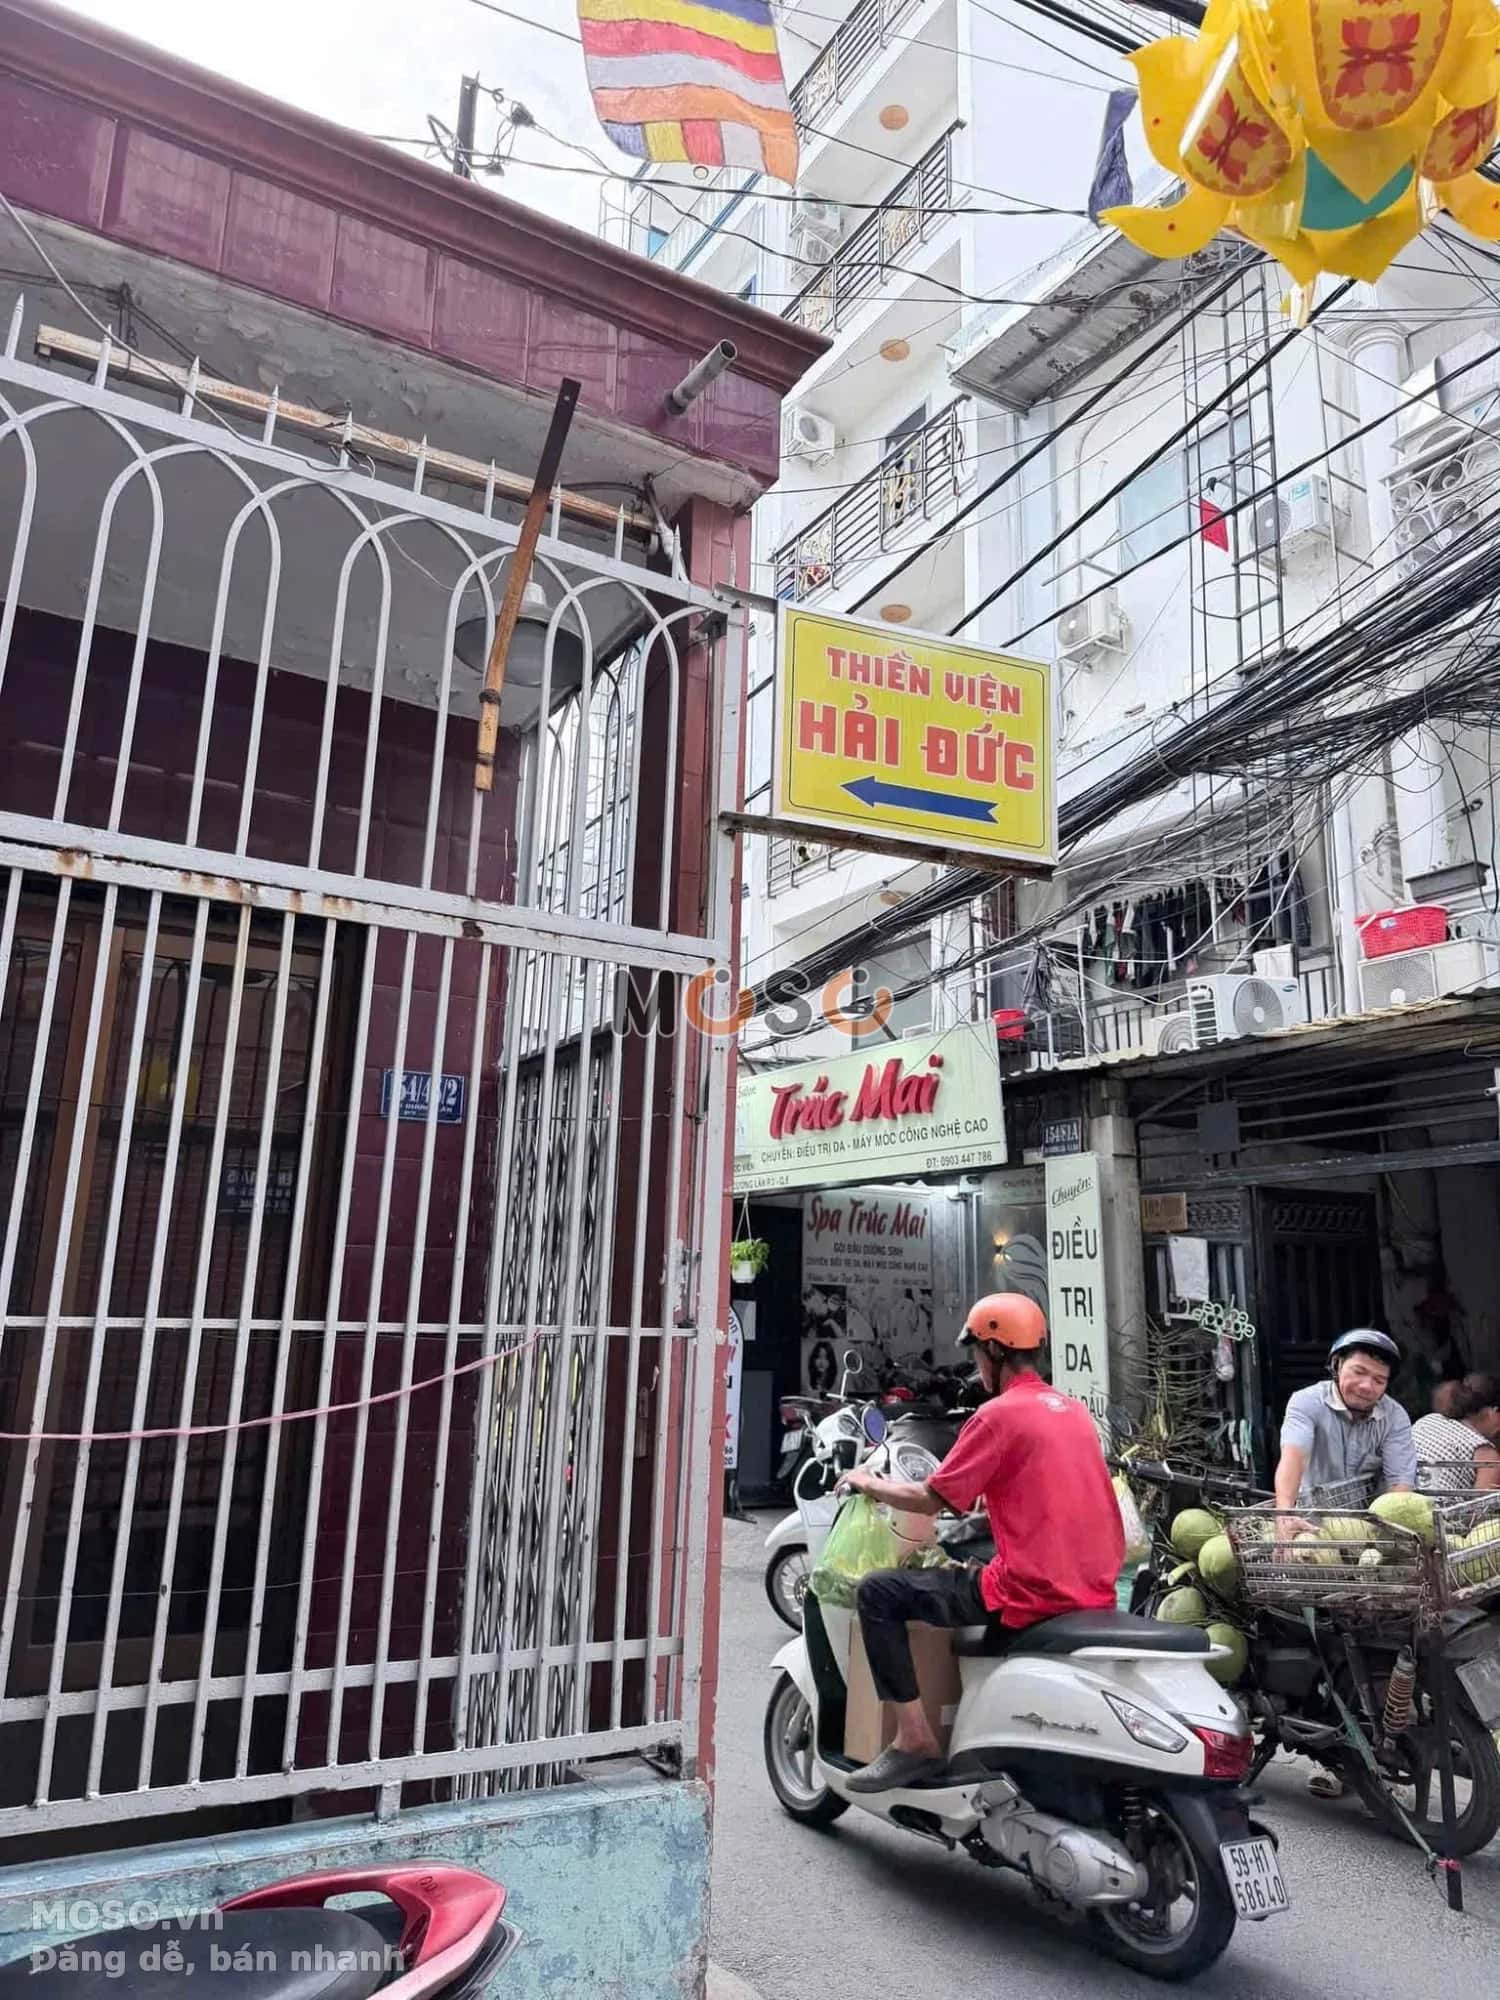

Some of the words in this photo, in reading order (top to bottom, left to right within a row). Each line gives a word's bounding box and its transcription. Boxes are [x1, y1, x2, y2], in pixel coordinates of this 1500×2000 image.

[827, 647, 931, 697] THIỀN
[944, 671, 1023, 717] VIỆN
[799, 693, 900, 768] HẢI
[920, 722, 1035, 791] ĐỨC
[769, 1075, 849, 1140] Trúc
[850, 1054, 945, 1122] Mai
[833, 1140, 846, 1153] DA
[852, 1133, 873, 1150] MÁY
[899, 1126, 929, 1144] CÔNG
[931, 1118, 962, 1139] NGHỆ
[964, 1117, 989, 1135] CAO
[807, 1194, 842, 1242] Spa
[849, 1198, 889, 1236] Trúc
[890, 1201, 928, 1240] Mai
[1052, 1216, 1098, 1260] ĐIỀU
[1060, 1286, 1095, 1325] TRỊ
[1065, 1343, 1093, 1374] DA
